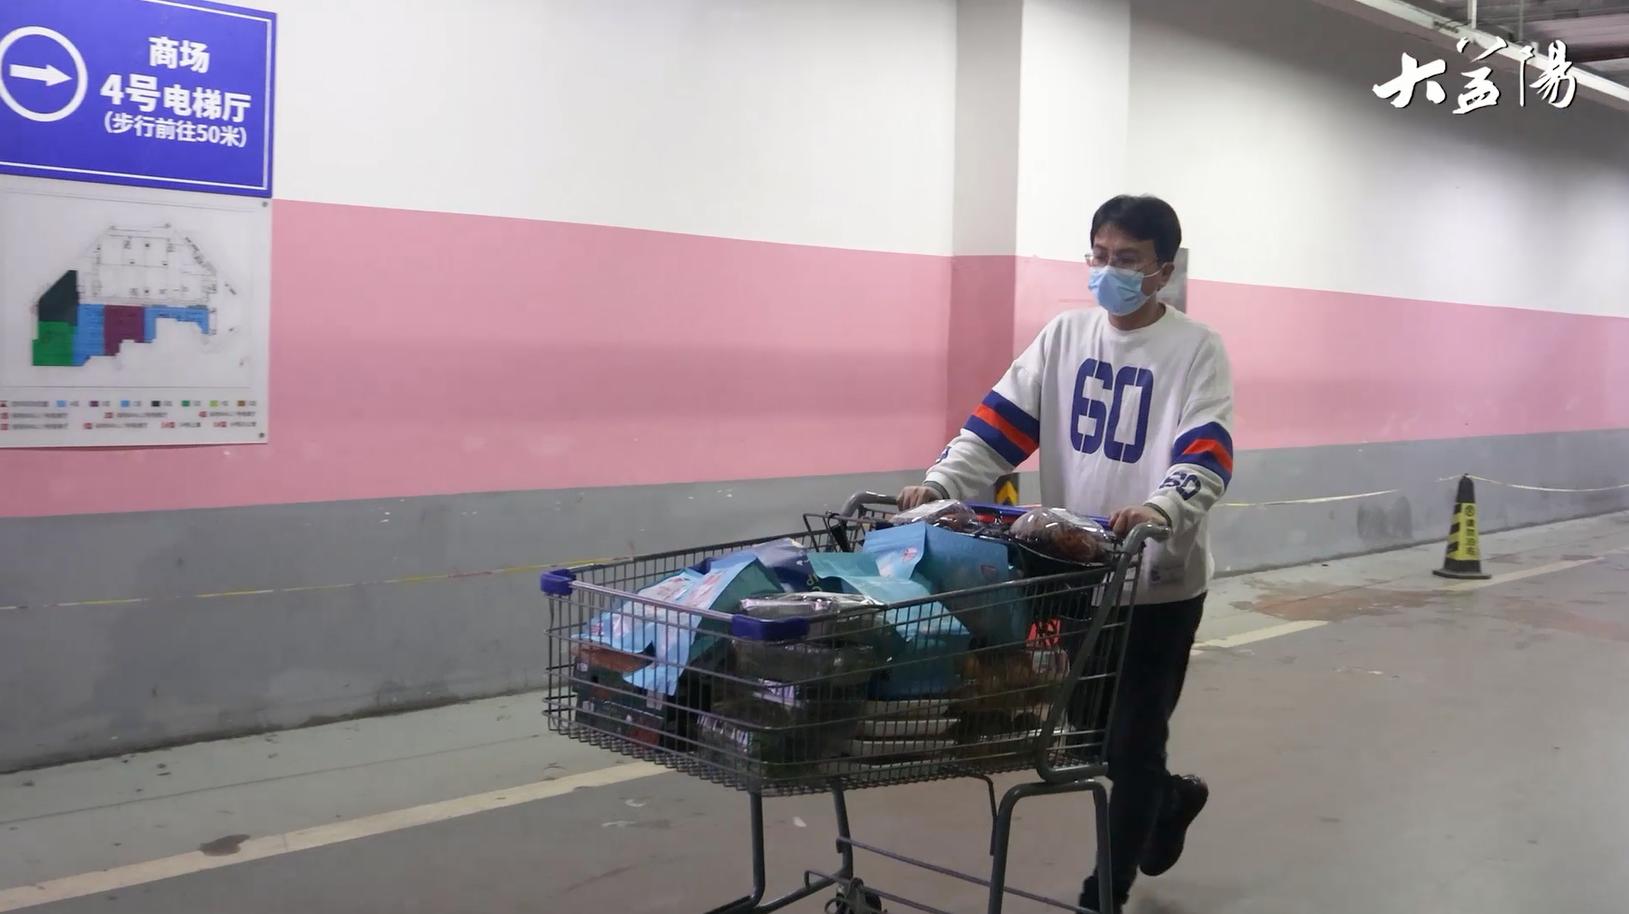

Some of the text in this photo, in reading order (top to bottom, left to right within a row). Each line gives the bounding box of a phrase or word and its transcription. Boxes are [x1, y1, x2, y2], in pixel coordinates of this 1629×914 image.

[149, 36, 210, 74] 商场
[100, 73, 252, 123] 4号电梯厅
[104, 111, 247, 148] (步行前往50米)
[1070, 358, 1154, 464] 60
[1158, 471, 1202, 501] 60
